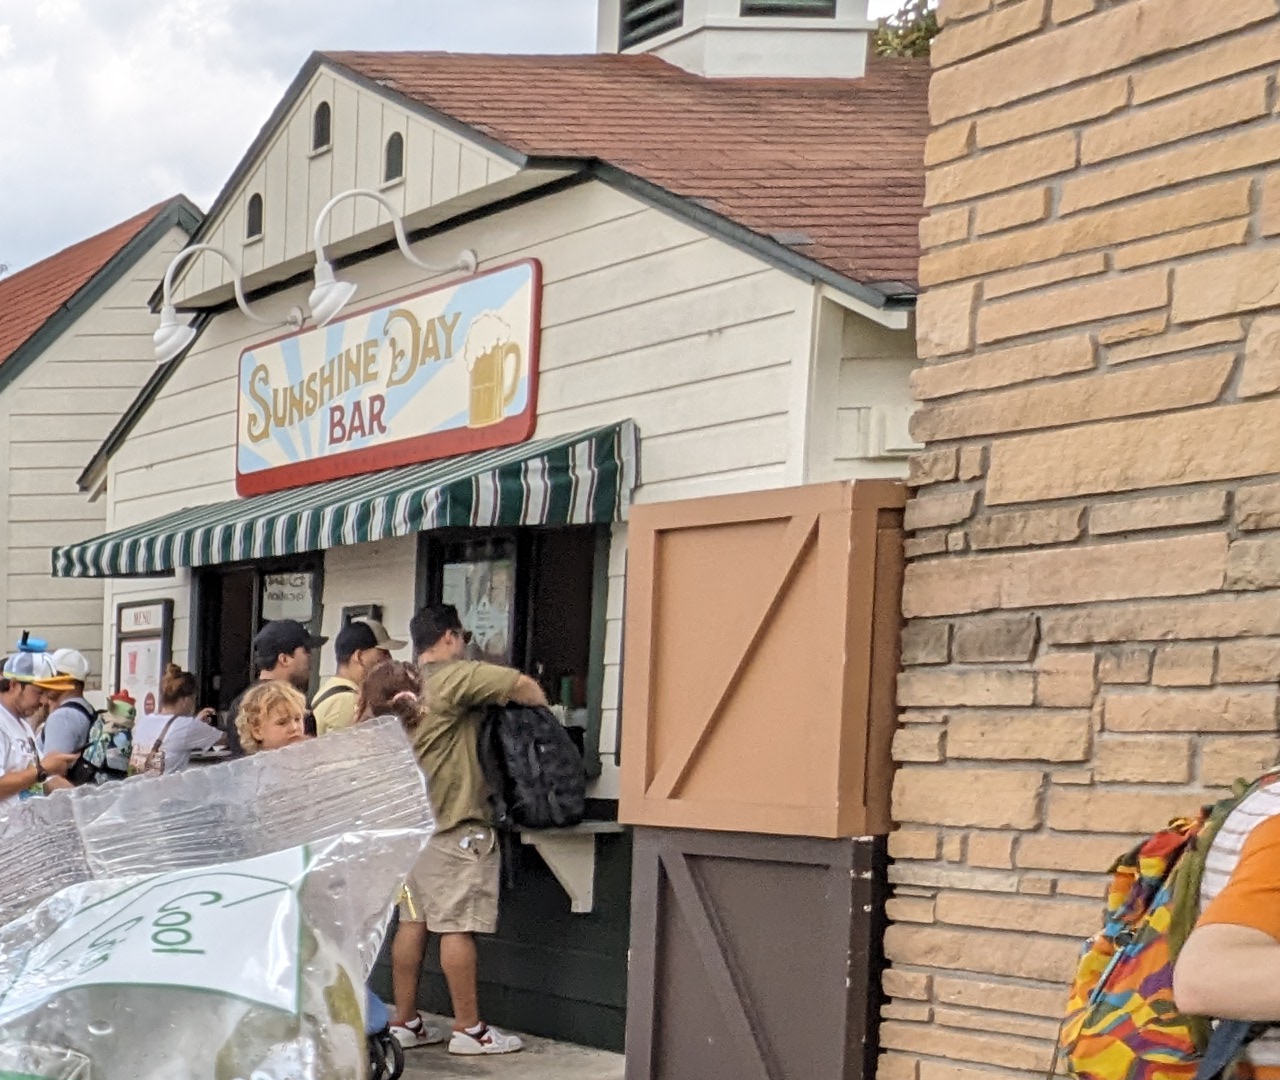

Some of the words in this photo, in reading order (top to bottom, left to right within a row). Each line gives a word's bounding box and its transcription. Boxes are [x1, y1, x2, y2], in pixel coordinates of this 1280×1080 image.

[247, 338, 379, 443] SUNSHINE
[383, 308, 462, 388] DAY
[328, 394, 387, 446] BAR
[133, 609, 152, 626] MENU
[151, 890, 223, 955] Cool
